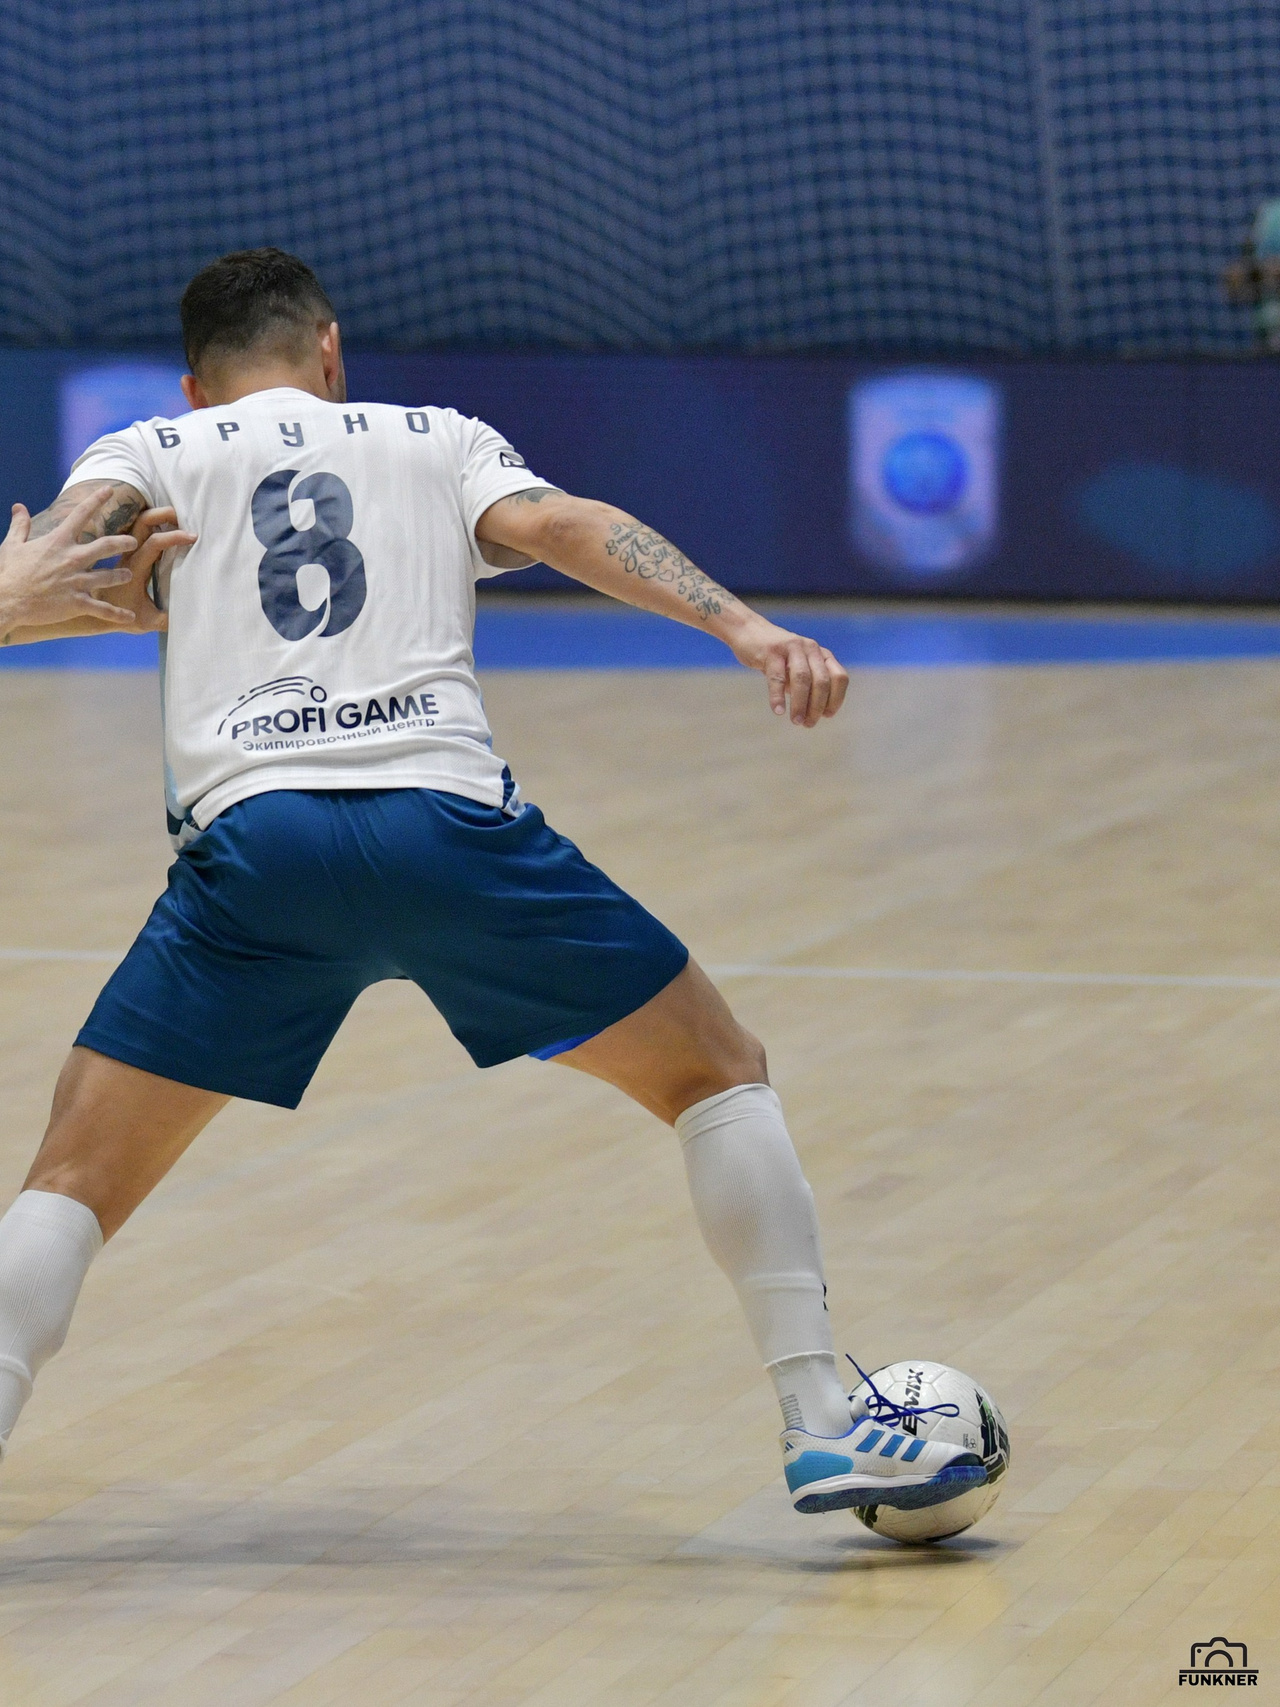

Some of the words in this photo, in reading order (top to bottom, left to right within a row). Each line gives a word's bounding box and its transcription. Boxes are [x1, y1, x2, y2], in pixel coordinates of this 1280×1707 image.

[156, 411, 431, 449] БРУНО
[250, 469, 368, 642] 8
[230, 707, 327, 740] PROFI
[335, 693, 440, 729] GAME
[241, 726, 382, 752] Экипировочный
[386, 718, 436, 734] центр
